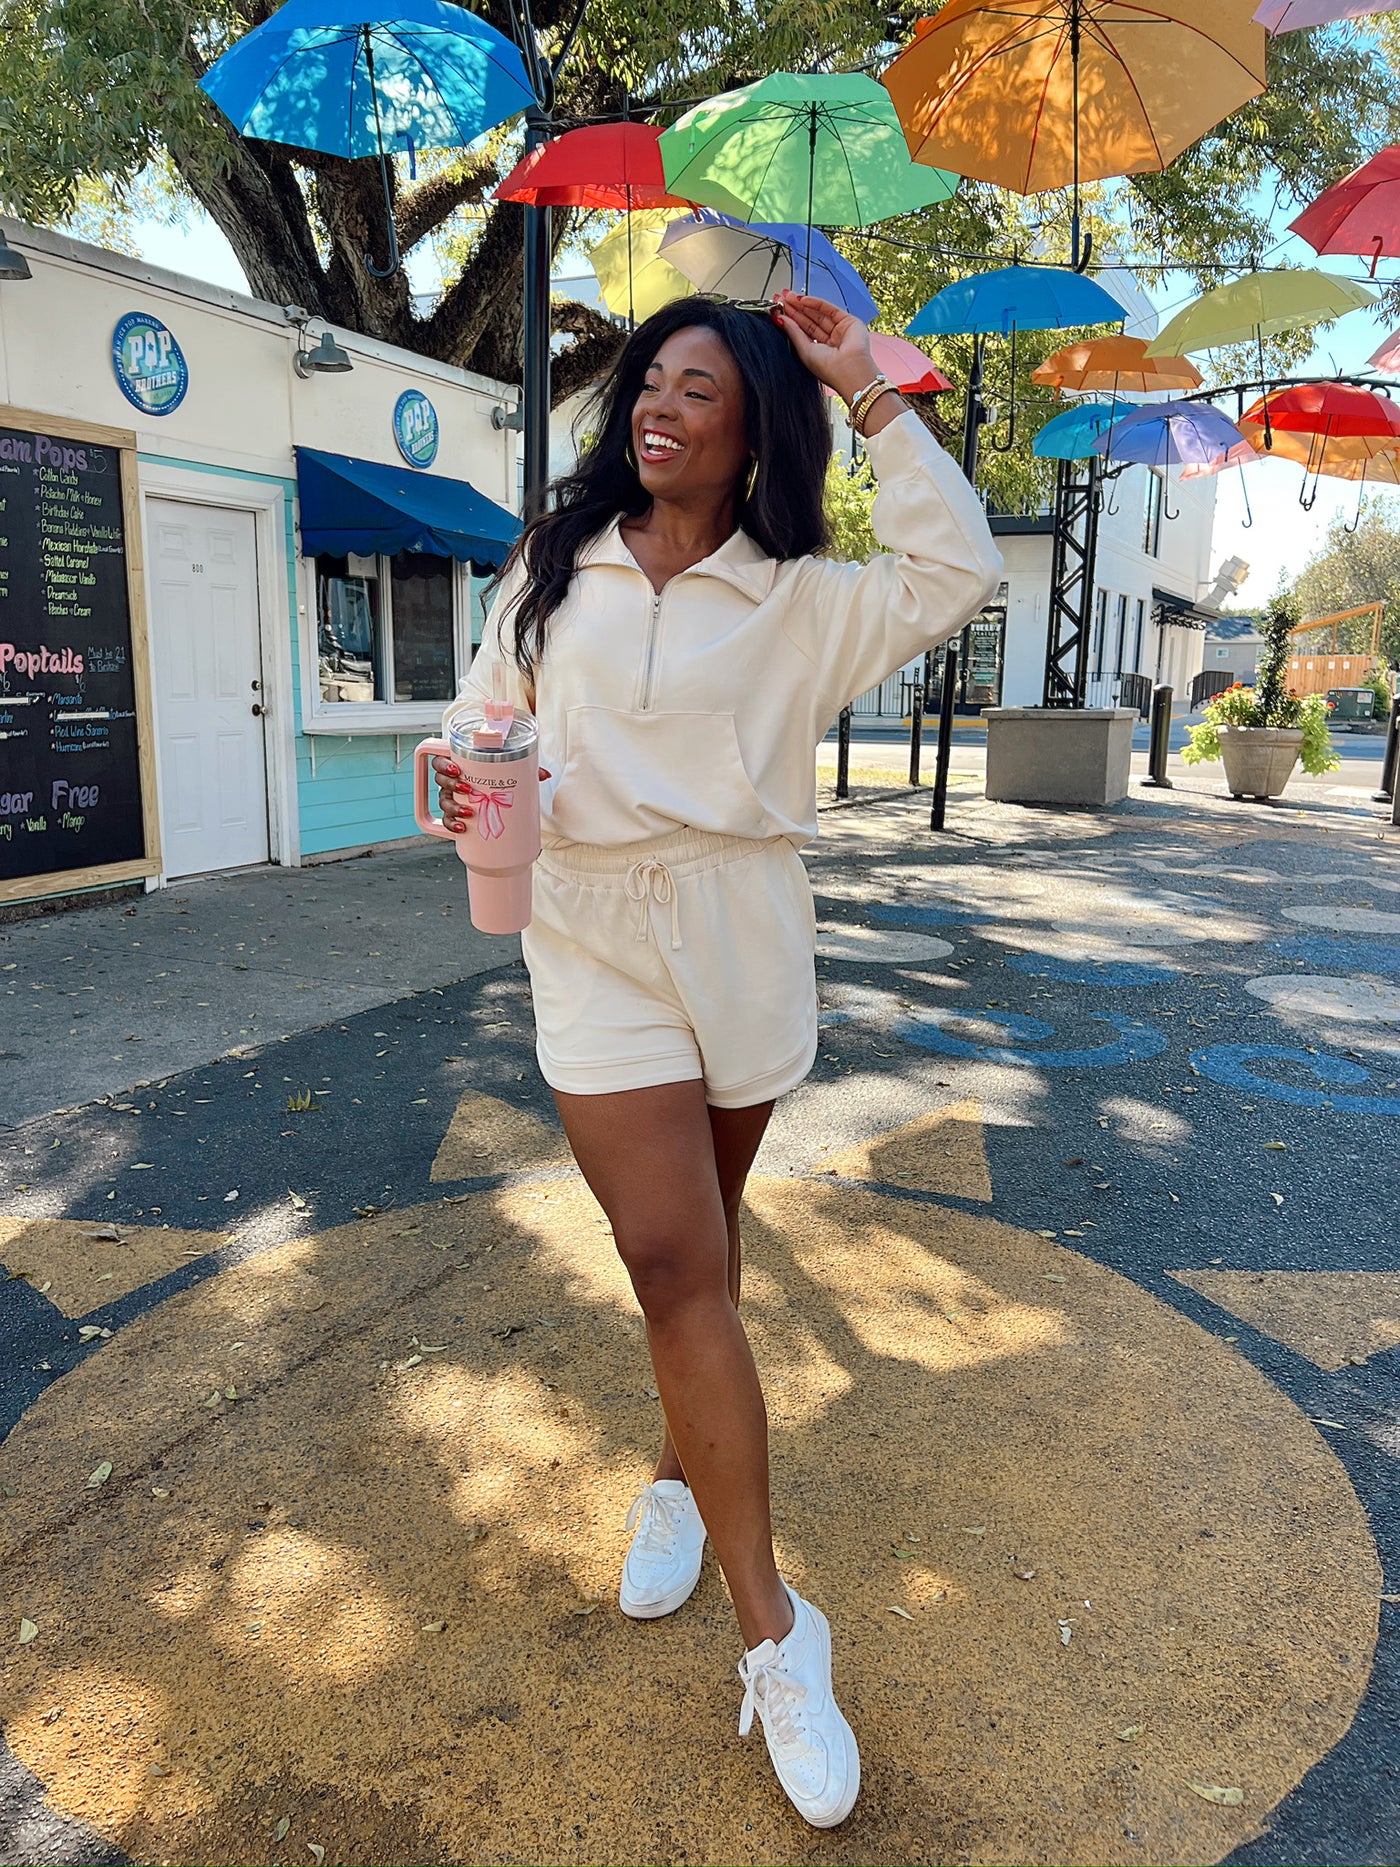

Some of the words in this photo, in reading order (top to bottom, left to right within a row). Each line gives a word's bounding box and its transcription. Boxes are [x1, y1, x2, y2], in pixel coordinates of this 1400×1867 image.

[135, 371, 177, 393] BROTHERS
[34, 435, 88, 474] Pops
[39, 466, 59, 482] Cotton
[60, 467, 79, 485] Candy
[41, 484, 65, 499] Pistachio
[66, 487, 80, 502] Milk
[84, 491, 102, 506] Honey
[42, 501, 69, 518] Birthday
[70, 505, 85, 519] Cake
[41, 518, 63, 534] Banana
[64, 521, 87, 537] Pudding
[42, 537, 71, 552] Mexican
[43, 554, 65, 567] Salted
[66, 555, 89, 569] Caramel
[79, 572, 96, 585] Vanilla
[48, 602, 68, 615] Peaches
[73, 603, 91, 616] Cream
[0, 643, 84, 680] Poptails
[115, 646, 125, 659] 21
[54, 725, 69, 738] Red
[70, 725, 85, 737] Wine
[464, 774, 497, 786] MUZZIE
[51, 780, 100, 810] Free
[26, 816, 47, 832] Vanilla
[62, 812, 85, 833] Mango
